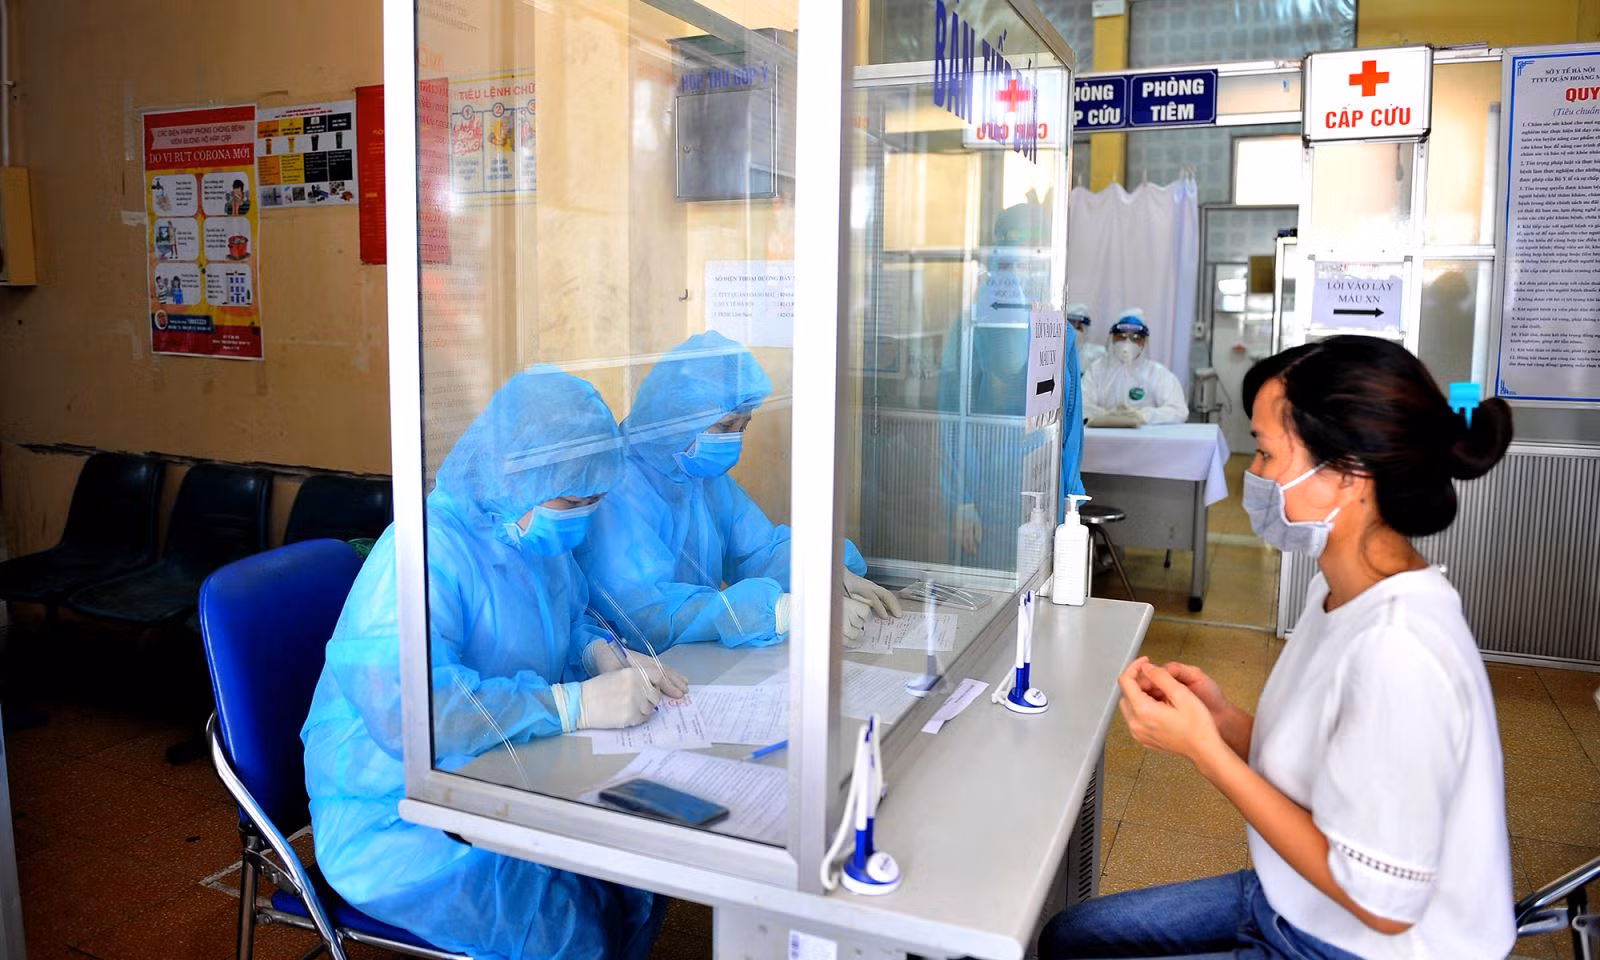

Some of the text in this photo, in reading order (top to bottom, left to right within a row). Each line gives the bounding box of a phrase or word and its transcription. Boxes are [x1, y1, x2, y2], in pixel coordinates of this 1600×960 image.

[1073, 82, 1114, 101] HÒNG
[1142, 77, 1205, 98] PHÒNG
[1150, 102, 1194, 121] TIÊM
[1325, 104, 1411, 129] CẤP CỨU
[149, 153, 162, 163] DO
[193, 147, 231, 160] CORONA
